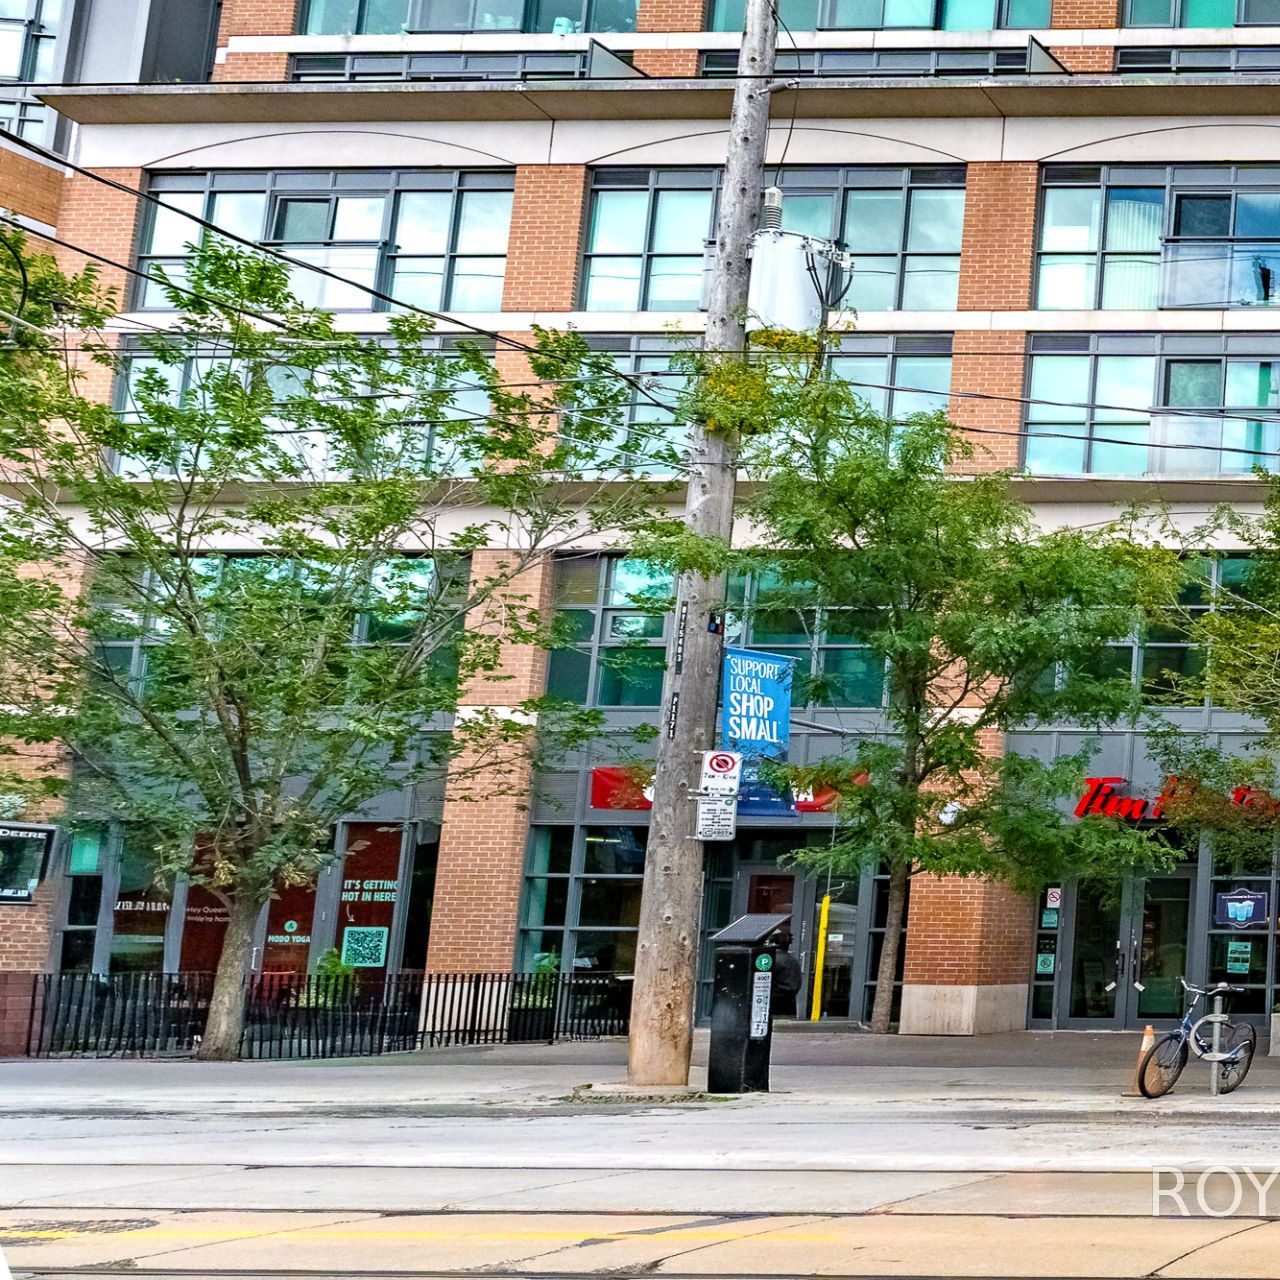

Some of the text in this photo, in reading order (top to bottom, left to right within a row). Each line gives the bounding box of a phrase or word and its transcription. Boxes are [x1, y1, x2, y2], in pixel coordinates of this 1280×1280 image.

[729, 657, 780, 679] SUPPORT
[730, 675, 765, 695] LOCAL
[729, 692, 775, 719] SHOP
[728, 716, 780, 743] SMALL
[1074, 777, 1149, 819] Tim
[343, 880, 361, 890] IT'S
[341, 891, 397, 902] HOT IN HERE
